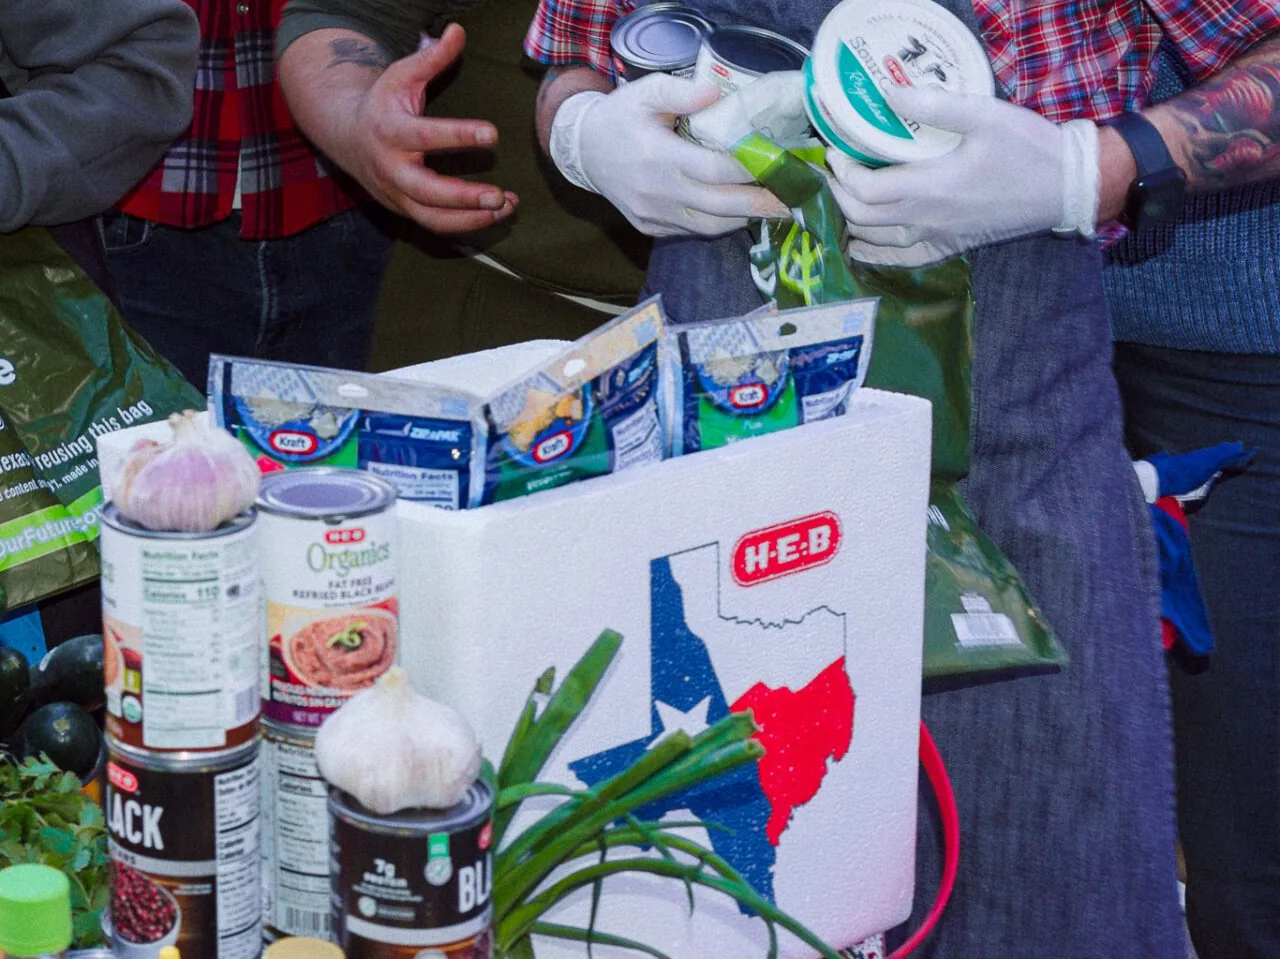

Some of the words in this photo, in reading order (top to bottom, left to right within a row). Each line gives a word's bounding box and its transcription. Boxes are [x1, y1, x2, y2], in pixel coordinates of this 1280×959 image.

[848, 35, 882, 76] Sour
[35, 434, 94, 471] reusing
[88, 416, 122, 437] this
[117, 399, 154, 426] bag
[278, 436, 306, 449] Kraft
[4, 478, 41, 500] content
[63, 464, 89, 483] made
[306, 541, 390, 578] Organics
[744, 524, 831, 575] H-E-B
